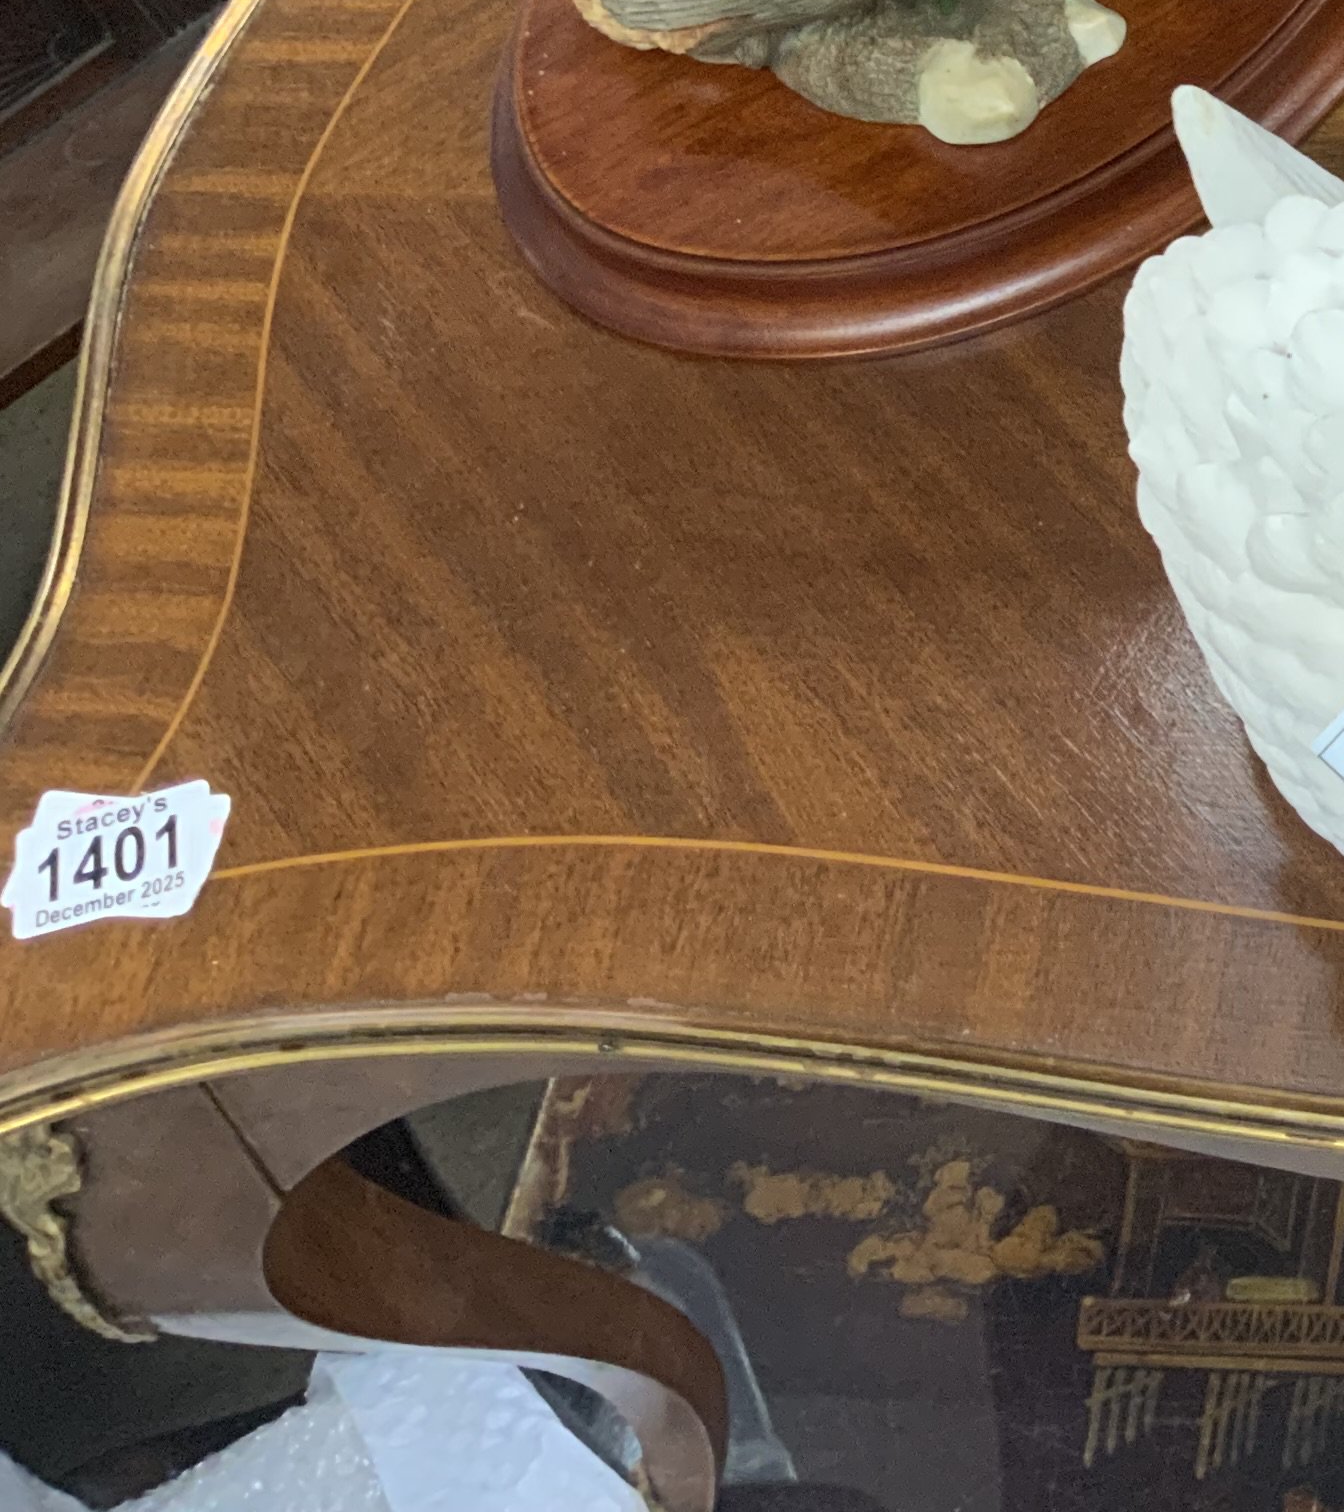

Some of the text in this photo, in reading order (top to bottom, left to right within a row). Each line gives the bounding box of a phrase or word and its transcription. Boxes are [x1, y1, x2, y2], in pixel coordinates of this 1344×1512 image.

[56, 796, 168, 840] Stacey's
[37, 814, 178, 902] 1401
[35, 870, 185, 928] December 2025
